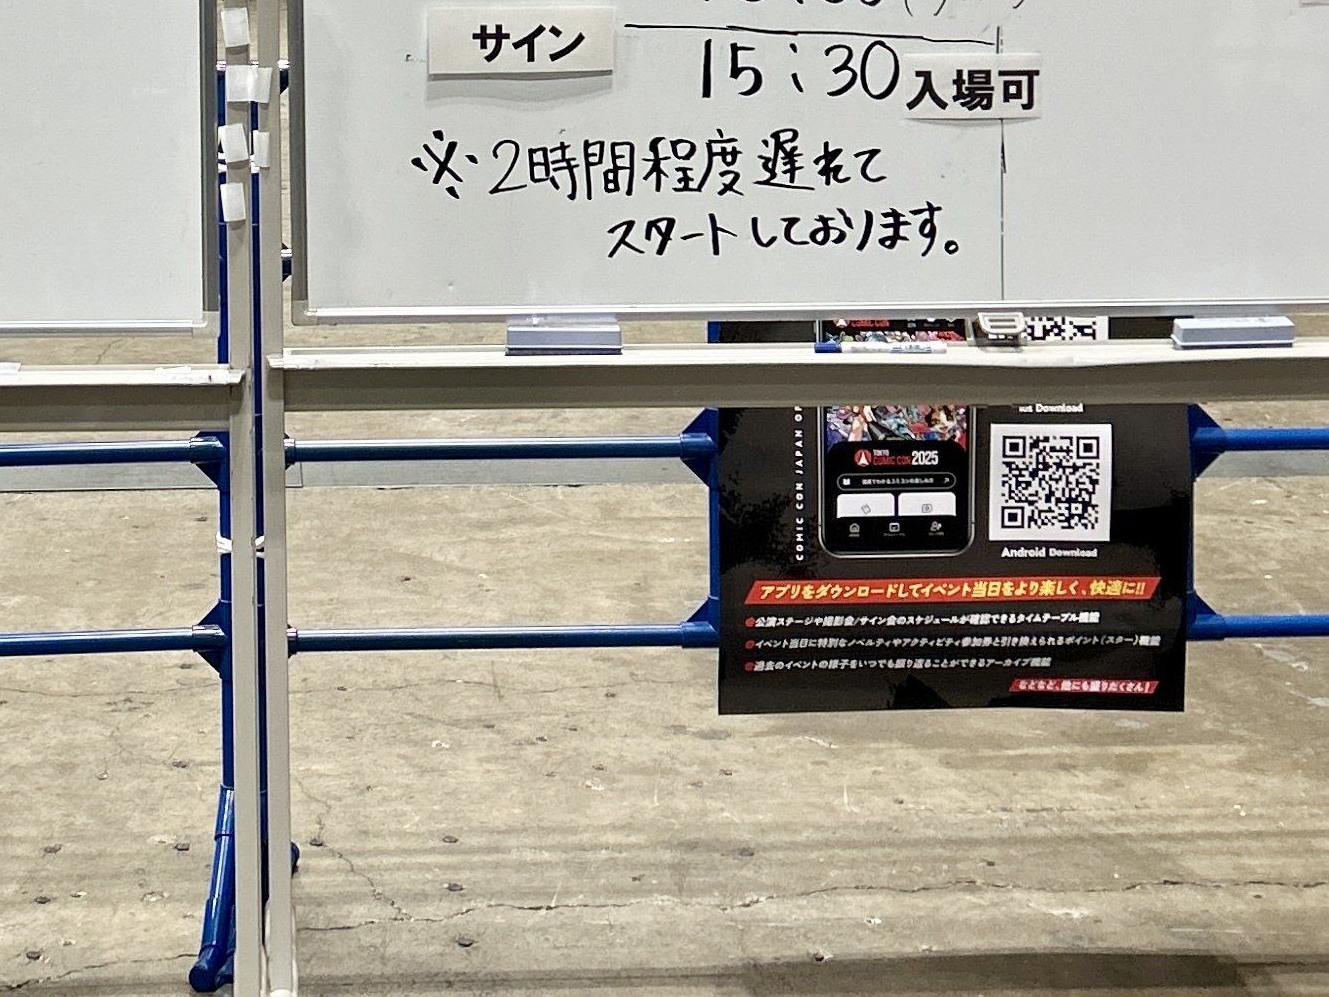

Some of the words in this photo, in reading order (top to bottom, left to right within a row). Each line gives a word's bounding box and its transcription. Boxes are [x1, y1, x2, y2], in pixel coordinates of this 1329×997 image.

[472, 25, 585, 62] サイン
[702, 39, 900, 100] 15:30
[906, 70, 1040, 111] 入場可
[1035, 403, 1084, 413] Download
[795, 430, 804, 475] JAPAN
[911, 450, 939, 465] 2025
[795, 483, 804, 510] CON
[795, 517, 804, 561] COMIC
[1001, 547, 1046, 558] Android
[1048, 547, 1098, 558] Download
